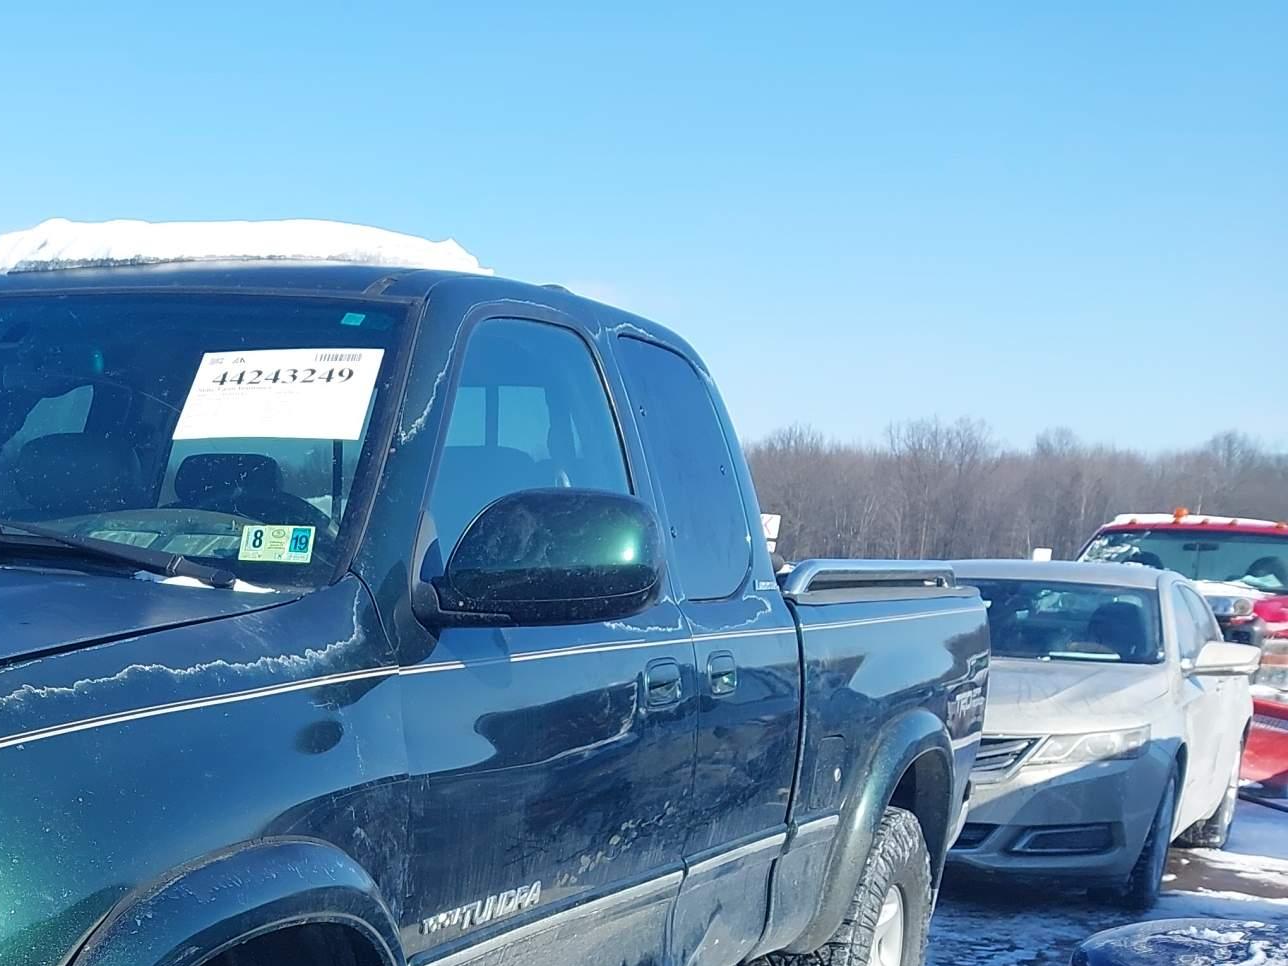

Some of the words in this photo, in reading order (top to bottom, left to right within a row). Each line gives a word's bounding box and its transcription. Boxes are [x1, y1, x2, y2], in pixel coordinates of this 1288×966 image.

[212, 367, 354, 386] 44243249
[252, 529, 264, 549] 8
[294, 534, 309, 551] 19
